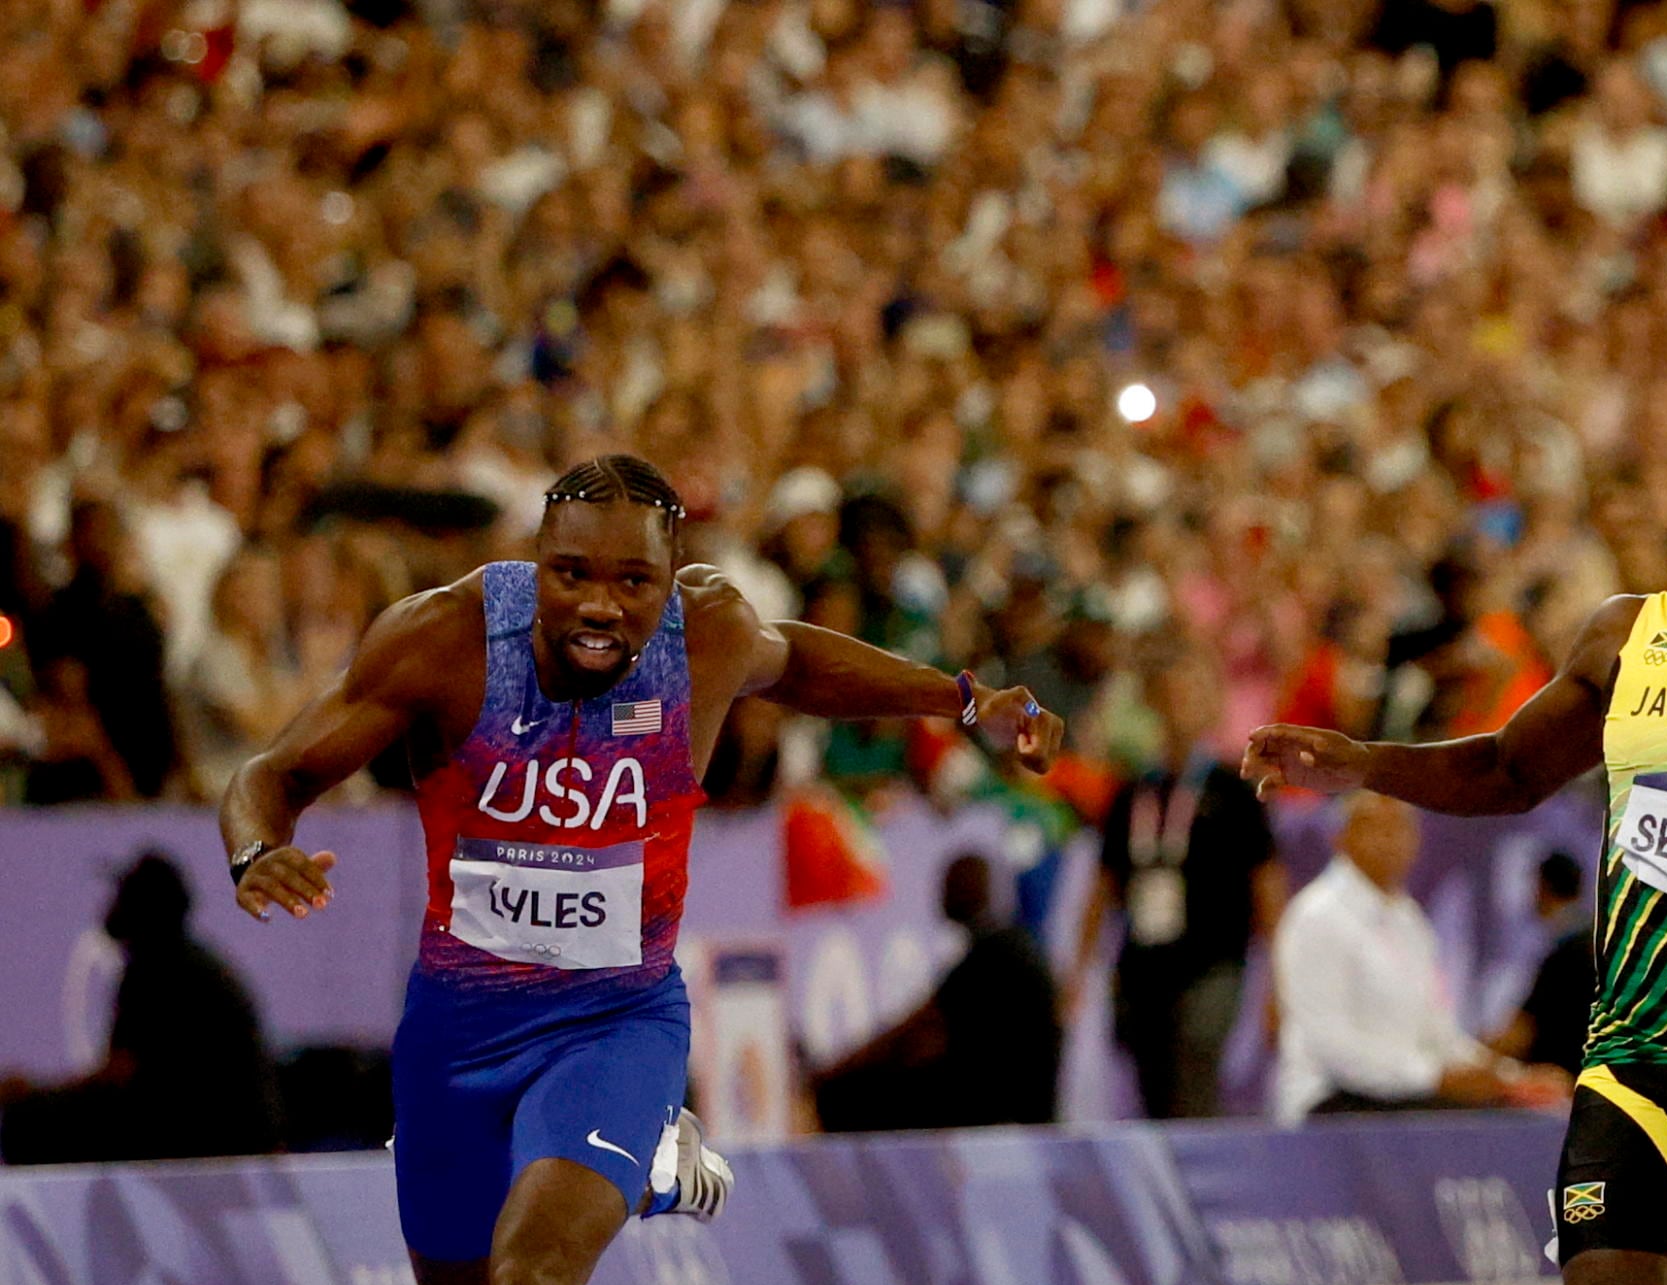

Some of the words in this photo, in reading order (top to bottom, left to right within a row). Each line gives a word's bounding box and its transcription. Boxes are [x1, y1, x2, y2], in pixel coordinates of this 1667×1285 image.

[477, 757, 648, 831] USA
[496, 846, 545, 862] PARIS
[550, 850, 596, 866] 2024
[488, 879, 607, 929] LYLES
